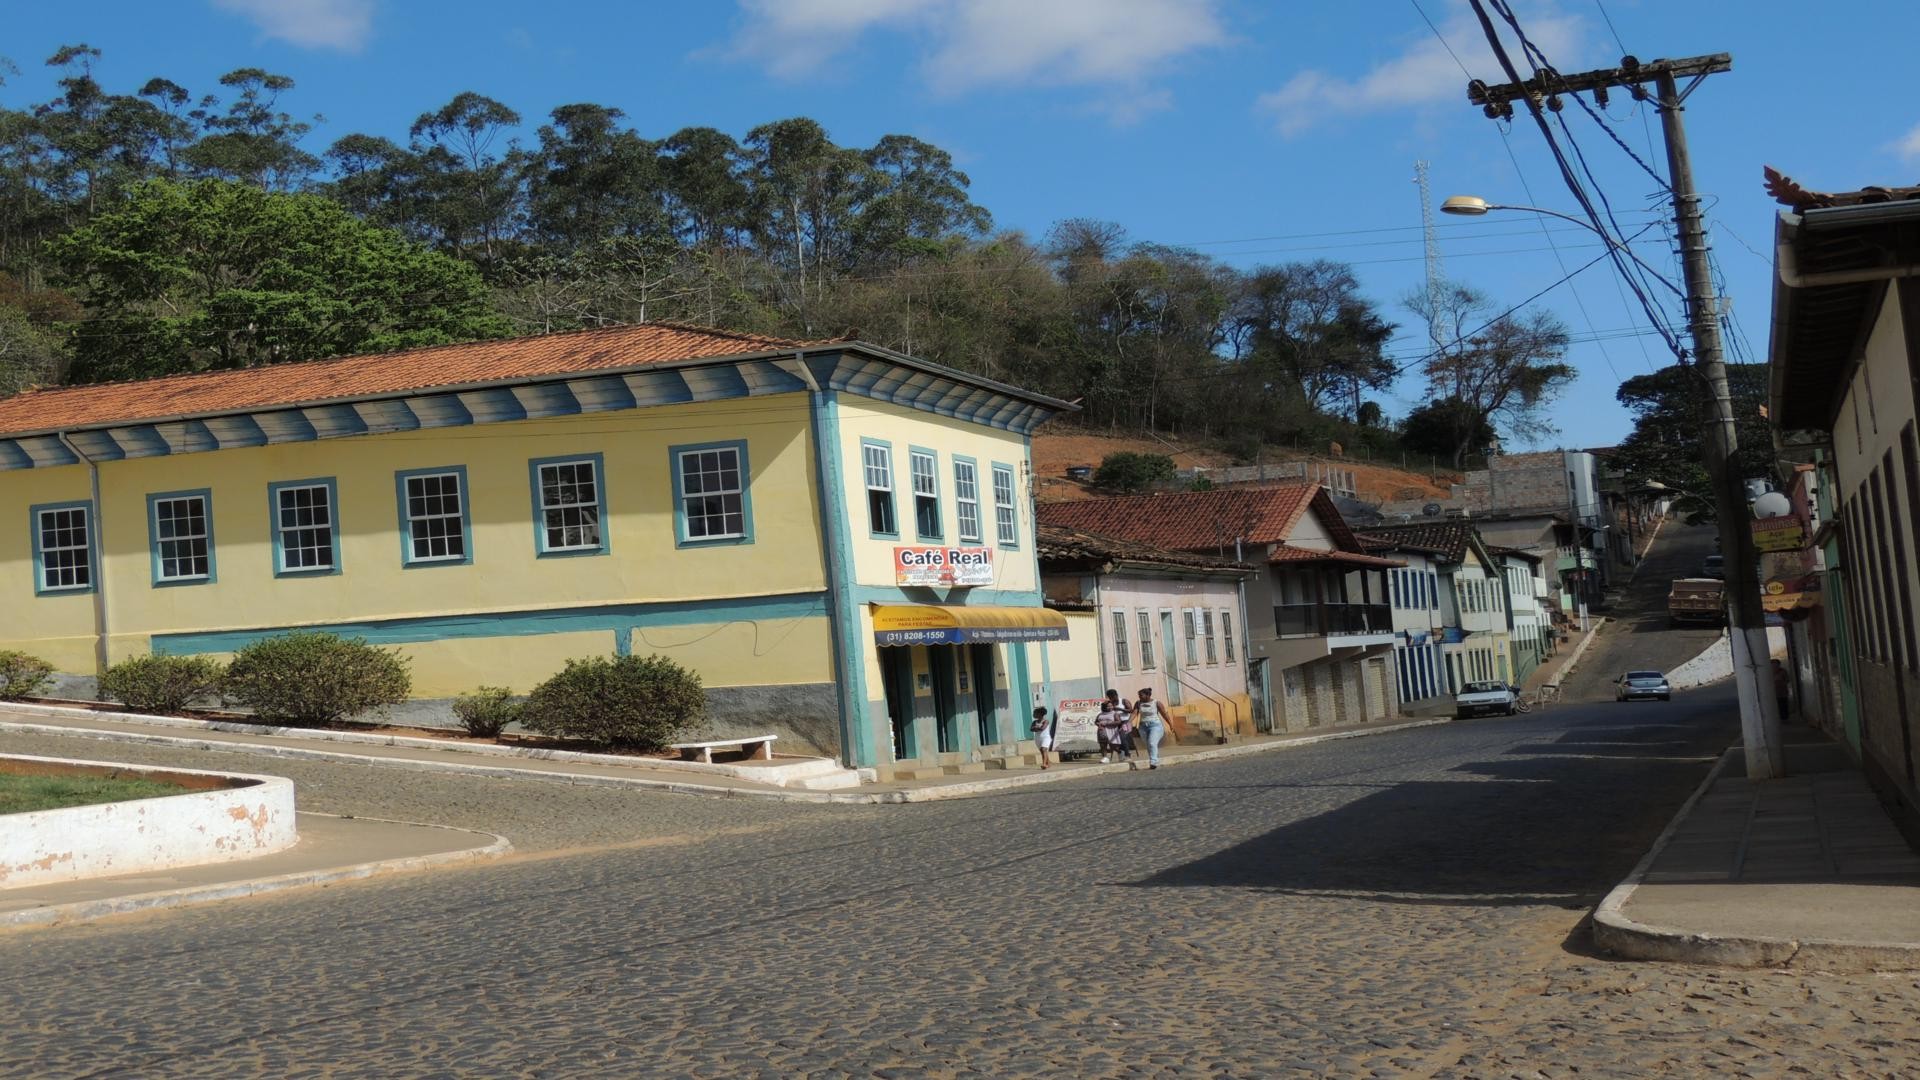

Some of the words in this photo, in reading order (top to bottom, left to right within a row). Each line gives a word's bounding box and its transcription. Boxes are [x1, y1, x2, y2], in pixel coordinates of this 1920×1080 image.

[901, 550, 942, 565] Café
[949, 551, 988, 564] Real
[886, 632, 902, 641] (31)
[904, 631, 945, 640] 8208-1550
